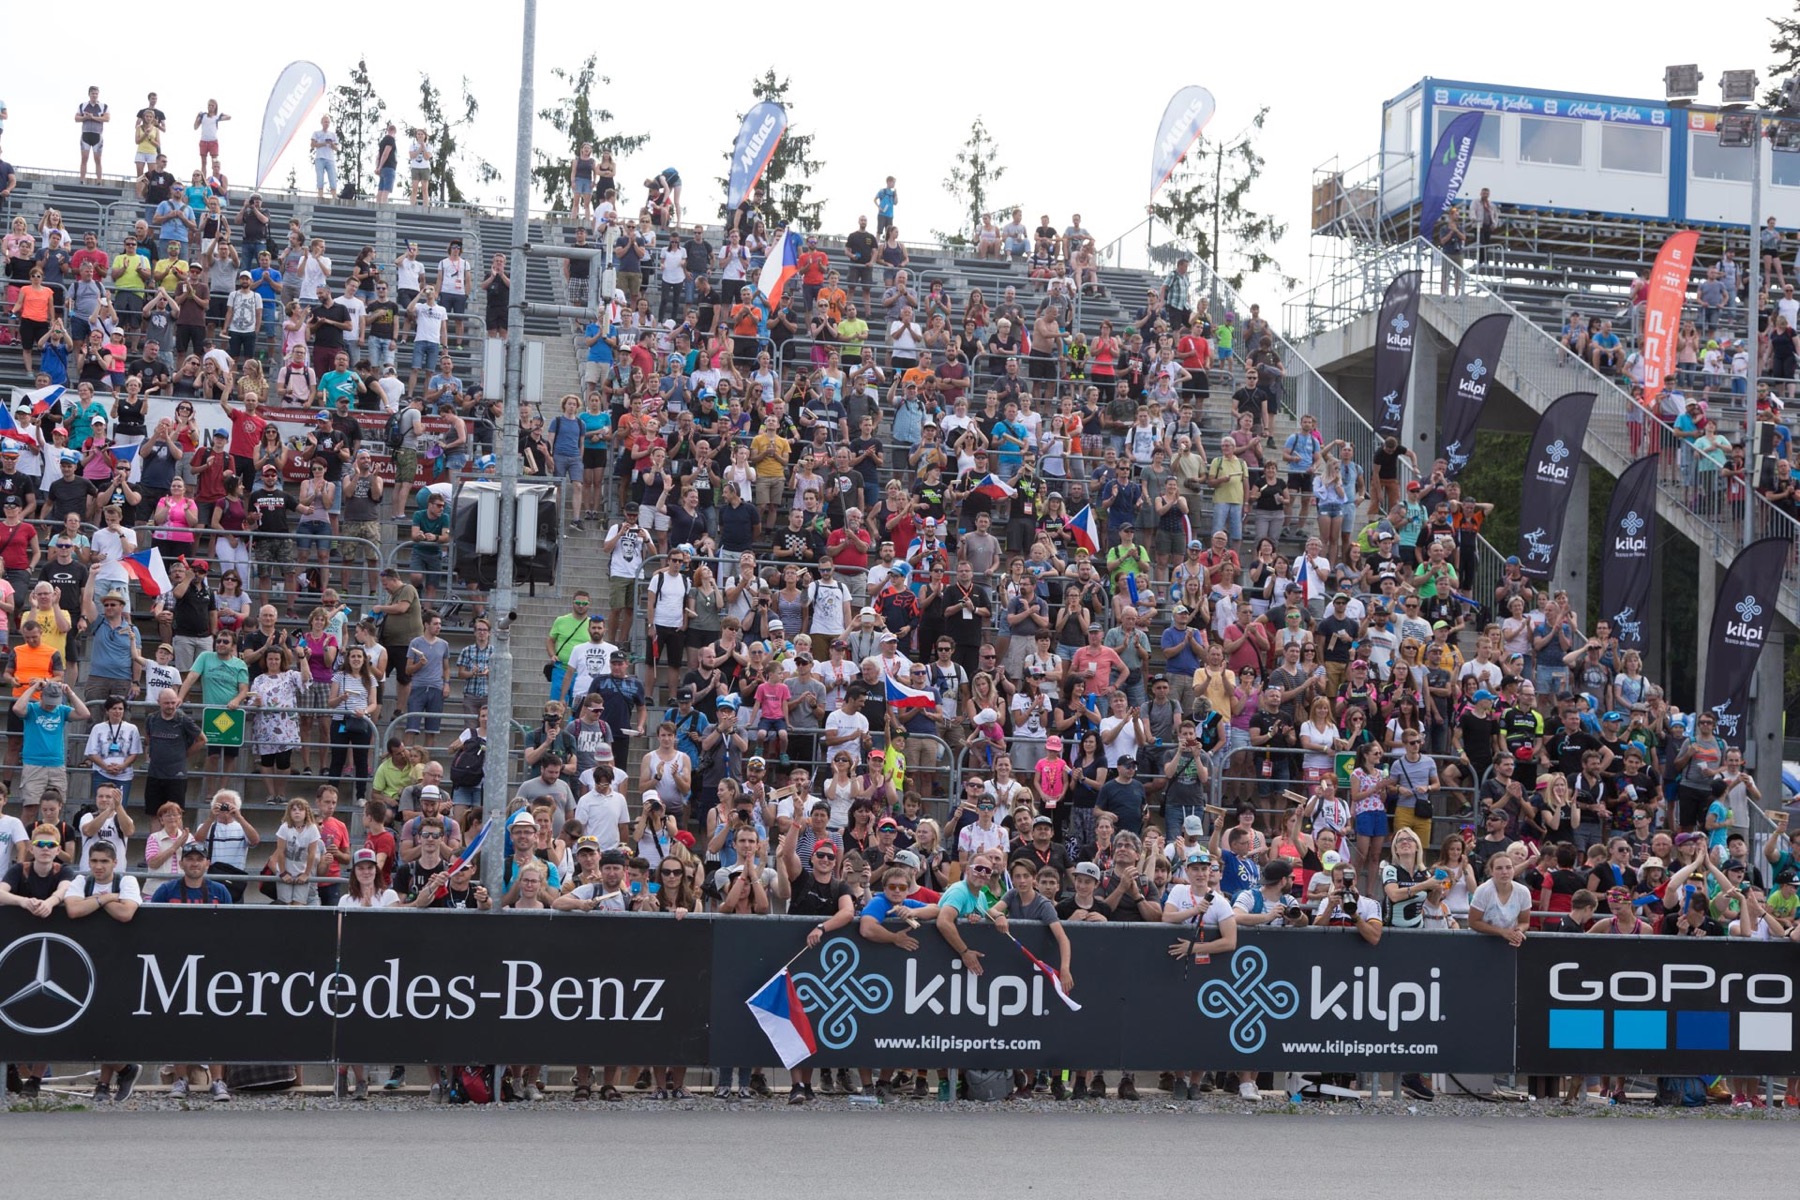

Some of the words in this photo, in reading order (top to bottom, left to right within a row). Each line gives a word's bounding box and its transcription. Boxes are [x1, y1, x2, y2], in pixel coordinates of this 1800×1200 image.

[273, 73, 312, 135] Mitas
[741, 113, 776, 174] Mitas
[1386, 333, 1411, 346] kilpi
[1459, 378, 1485, 395] kilpi
[1537, 461, 1569, 479] kilpi
[1615, 537, 1646, 551] kilpi
[1726, 621, 1762, 640] kilpi
[578, 741, 597, 752] HAR
[132, 954, 666, 1022] Mercedes-Benz
[905, 958, 1045, 1027] kilpi
[1549, 962, 1794, 1006] GoPro
[1311, 965, 1441, 1032] kilpi
[874, 1035, 1041, 1052] www.kilpisports.com
[1282, 1041, 1438, 1057] www.kilpisports.com
